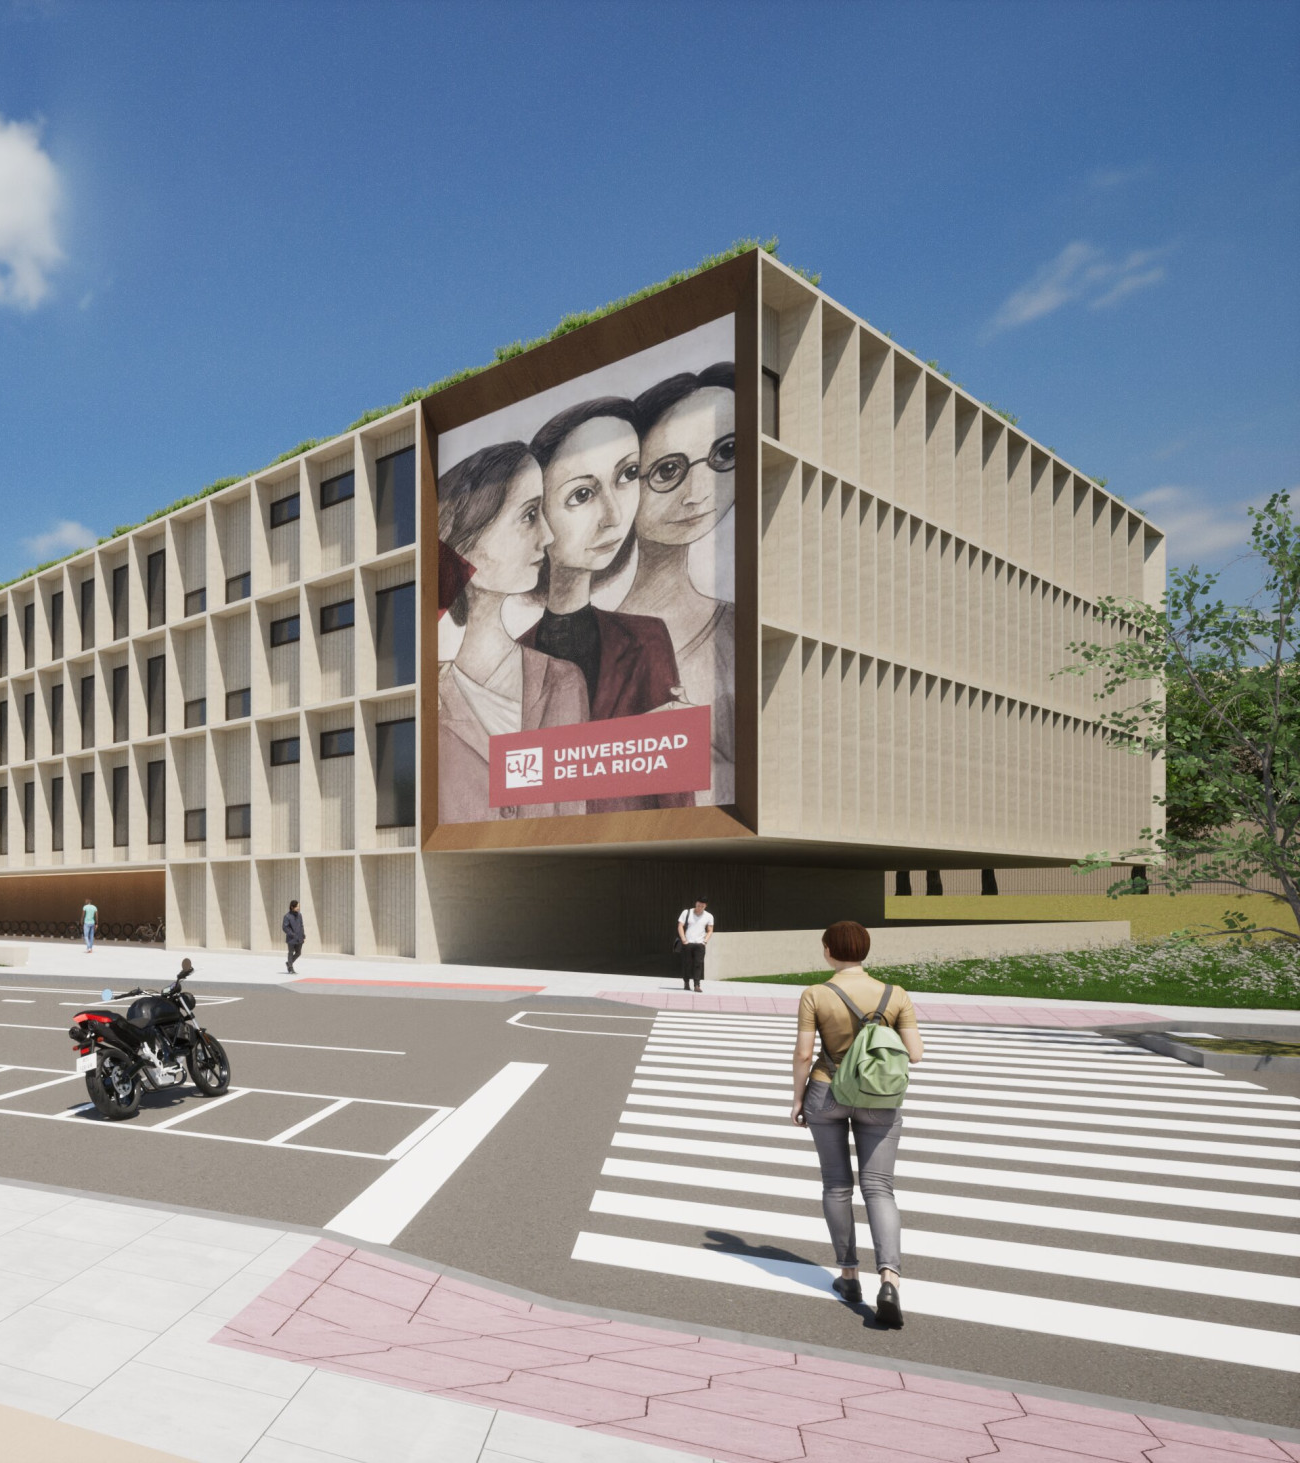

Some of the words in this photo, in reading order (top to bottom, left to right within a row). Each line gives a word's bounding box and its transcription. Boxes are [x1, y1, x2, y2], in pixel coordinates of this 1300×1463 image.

[554, 734, 688, 762] UNIVERSIDAD
[554, 765, 578, 780] DE
[583, 762, 607, 777] LA
[612, 755, 668, 774] RIOJA
